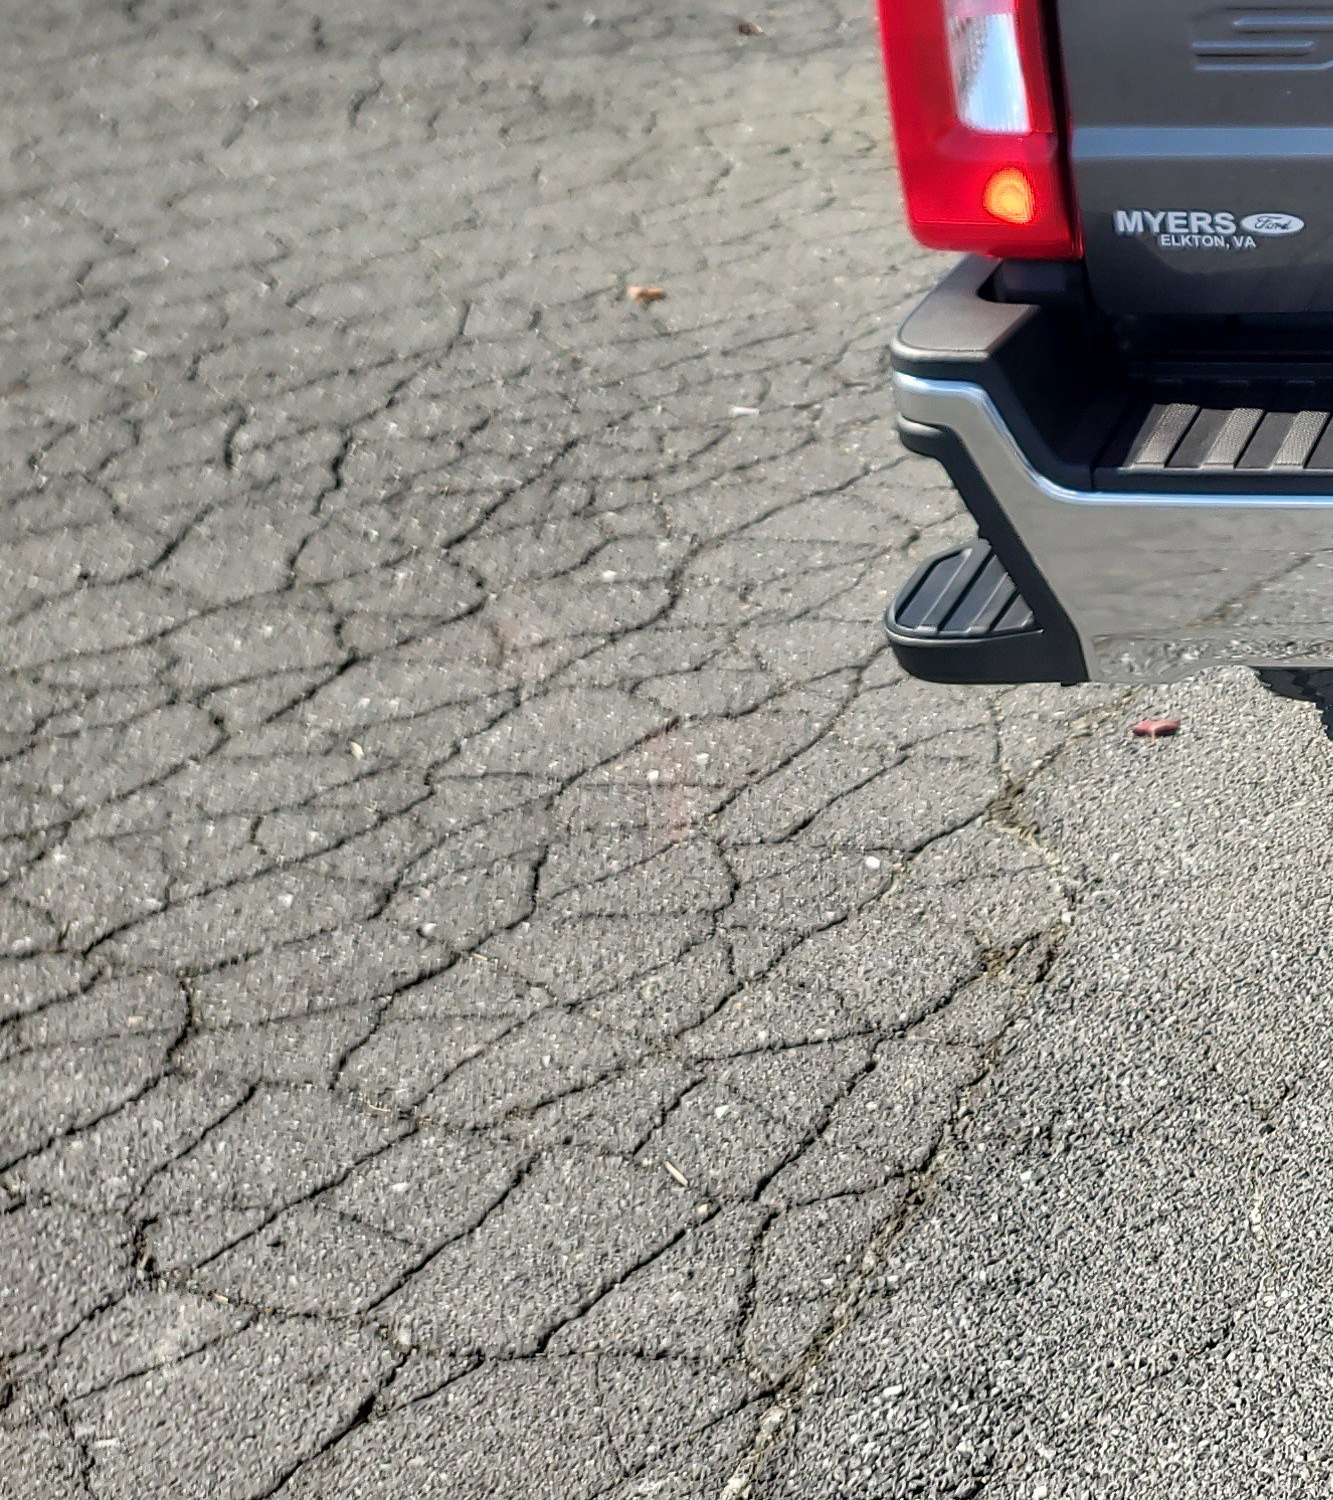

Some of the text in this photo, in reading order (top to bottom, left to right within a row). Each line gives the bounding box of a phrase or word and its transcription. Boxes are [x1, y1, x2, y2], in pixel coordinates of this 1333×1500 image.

[1114, 210, 1237, 234] MYERS
[1159, 234, 1257, 249] ELKTON, VA
